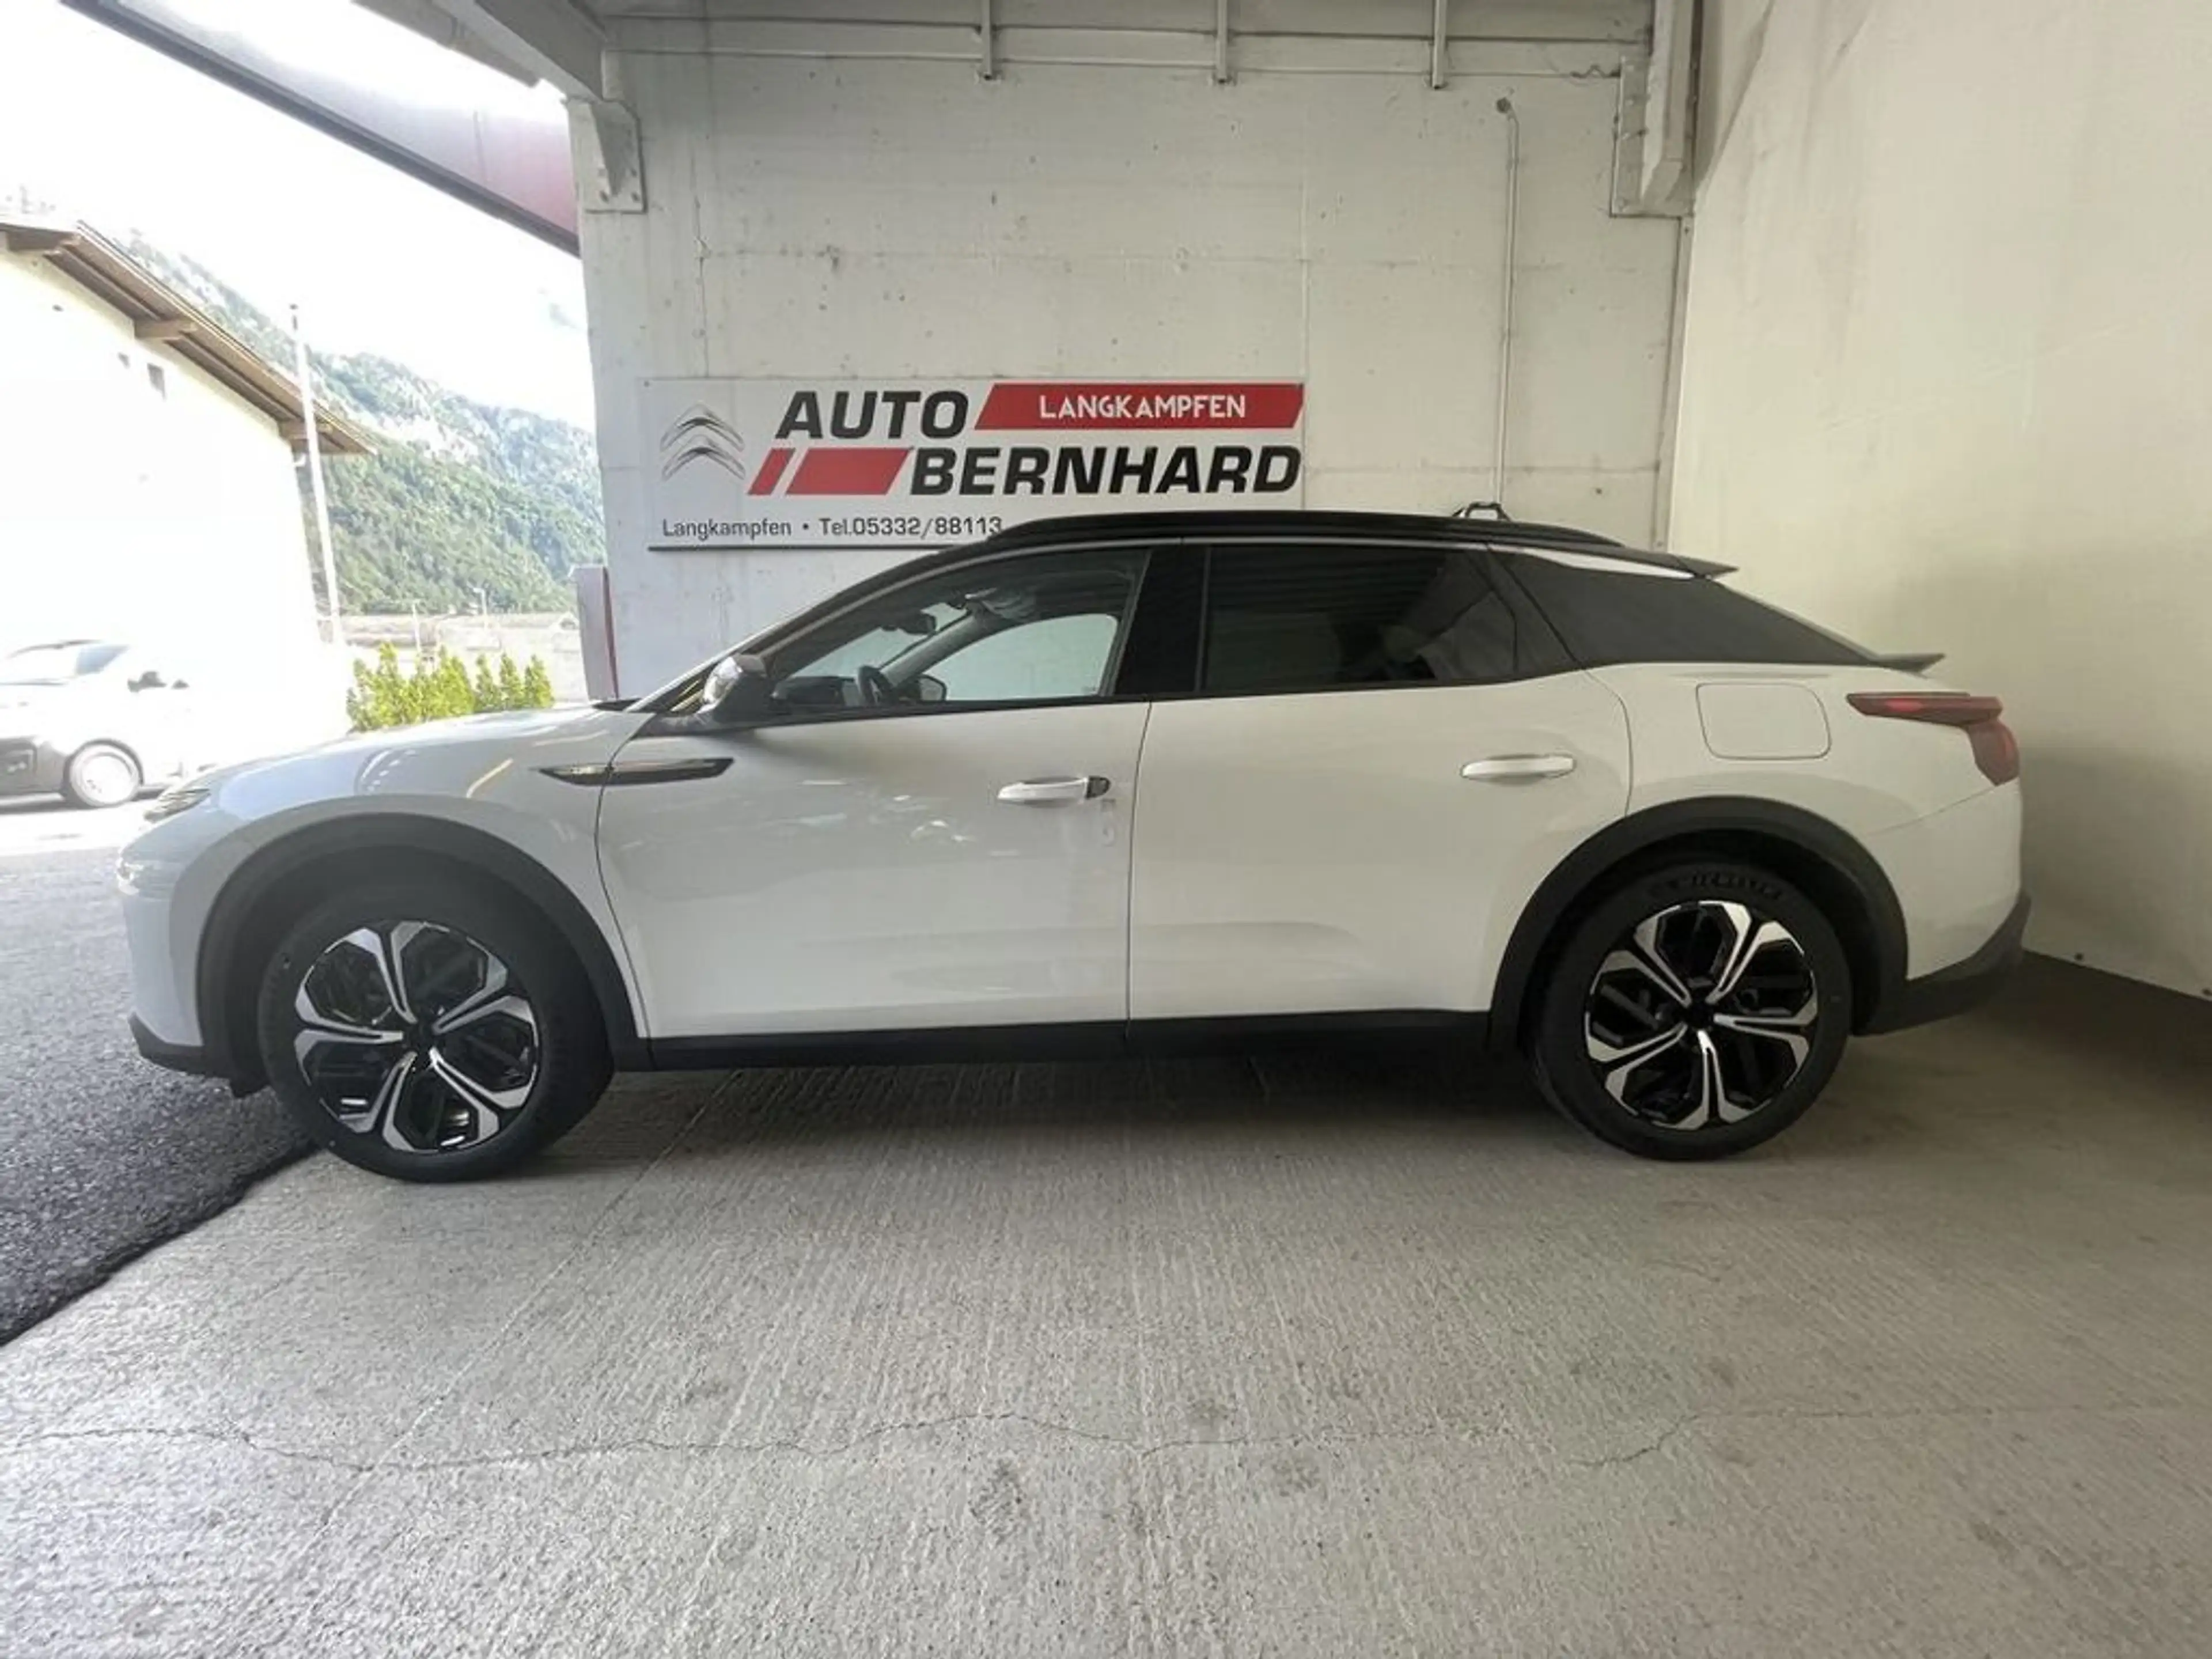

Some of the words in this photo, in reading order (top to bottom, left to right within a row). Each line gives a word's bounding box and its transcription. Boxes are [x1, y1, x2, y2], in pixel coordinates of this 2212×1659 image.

[775, 391, 969, 439] AUTO
[1039, 395, 1246, 419] LANGKAMPFEN
[910, 445, 1302, 495] BERNHARD
[662, 518, 792, 541] Langkampfen
